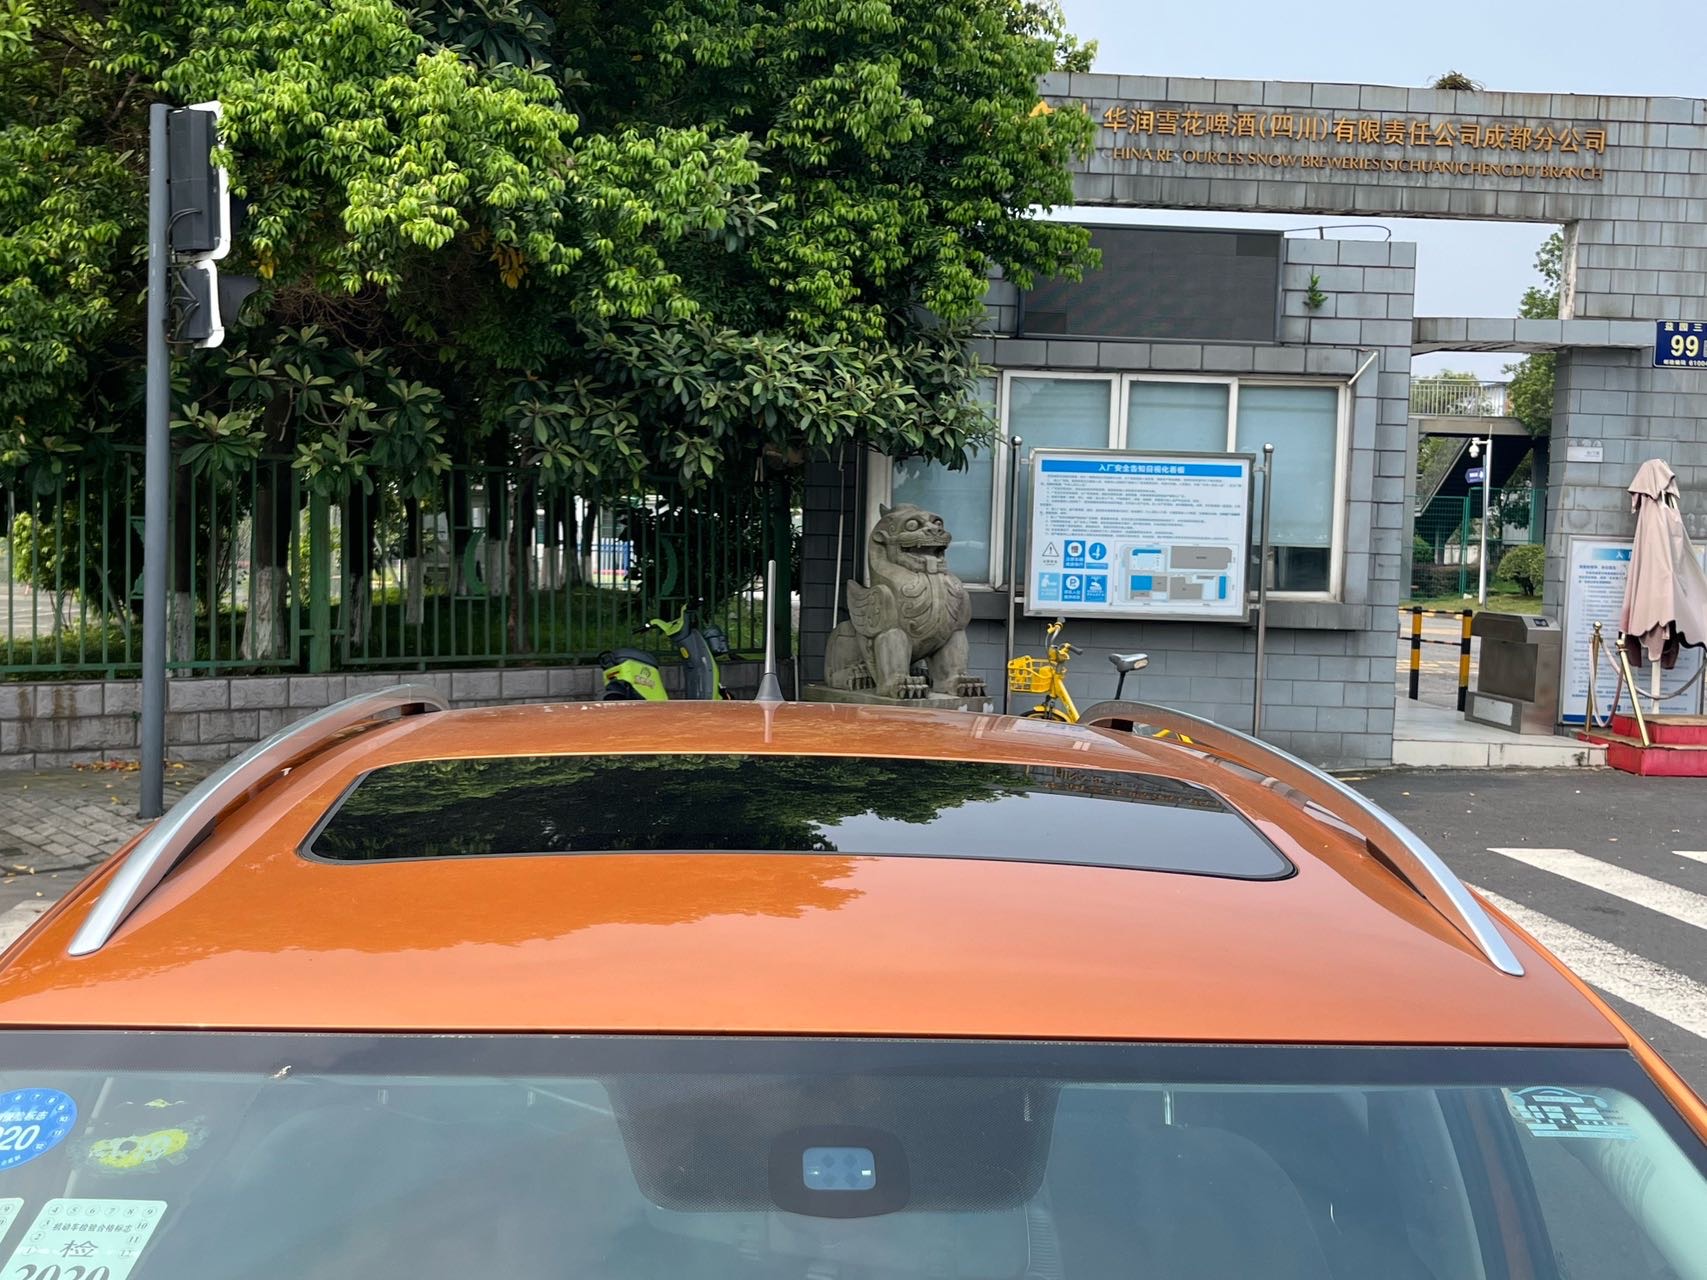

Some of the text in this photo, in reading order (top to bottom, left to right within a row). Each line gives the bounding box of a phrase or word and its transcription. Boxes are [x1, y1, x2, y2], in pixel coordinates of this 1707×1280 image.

[1103, 107, 1607, 154] 华润雪花啤酒(四川)有限责任公司成都分公司
[1247, 153, 1297, 168] SNOW
[1540, 165, 1603, 181] BRANCH
[1670, 335, 1699, 357] 99
[0, 1124, 41, 1151] 20
[52, 1222, 132, 1233] 机动车检验合格标志
[59, 1240, 99, 1258] 检
